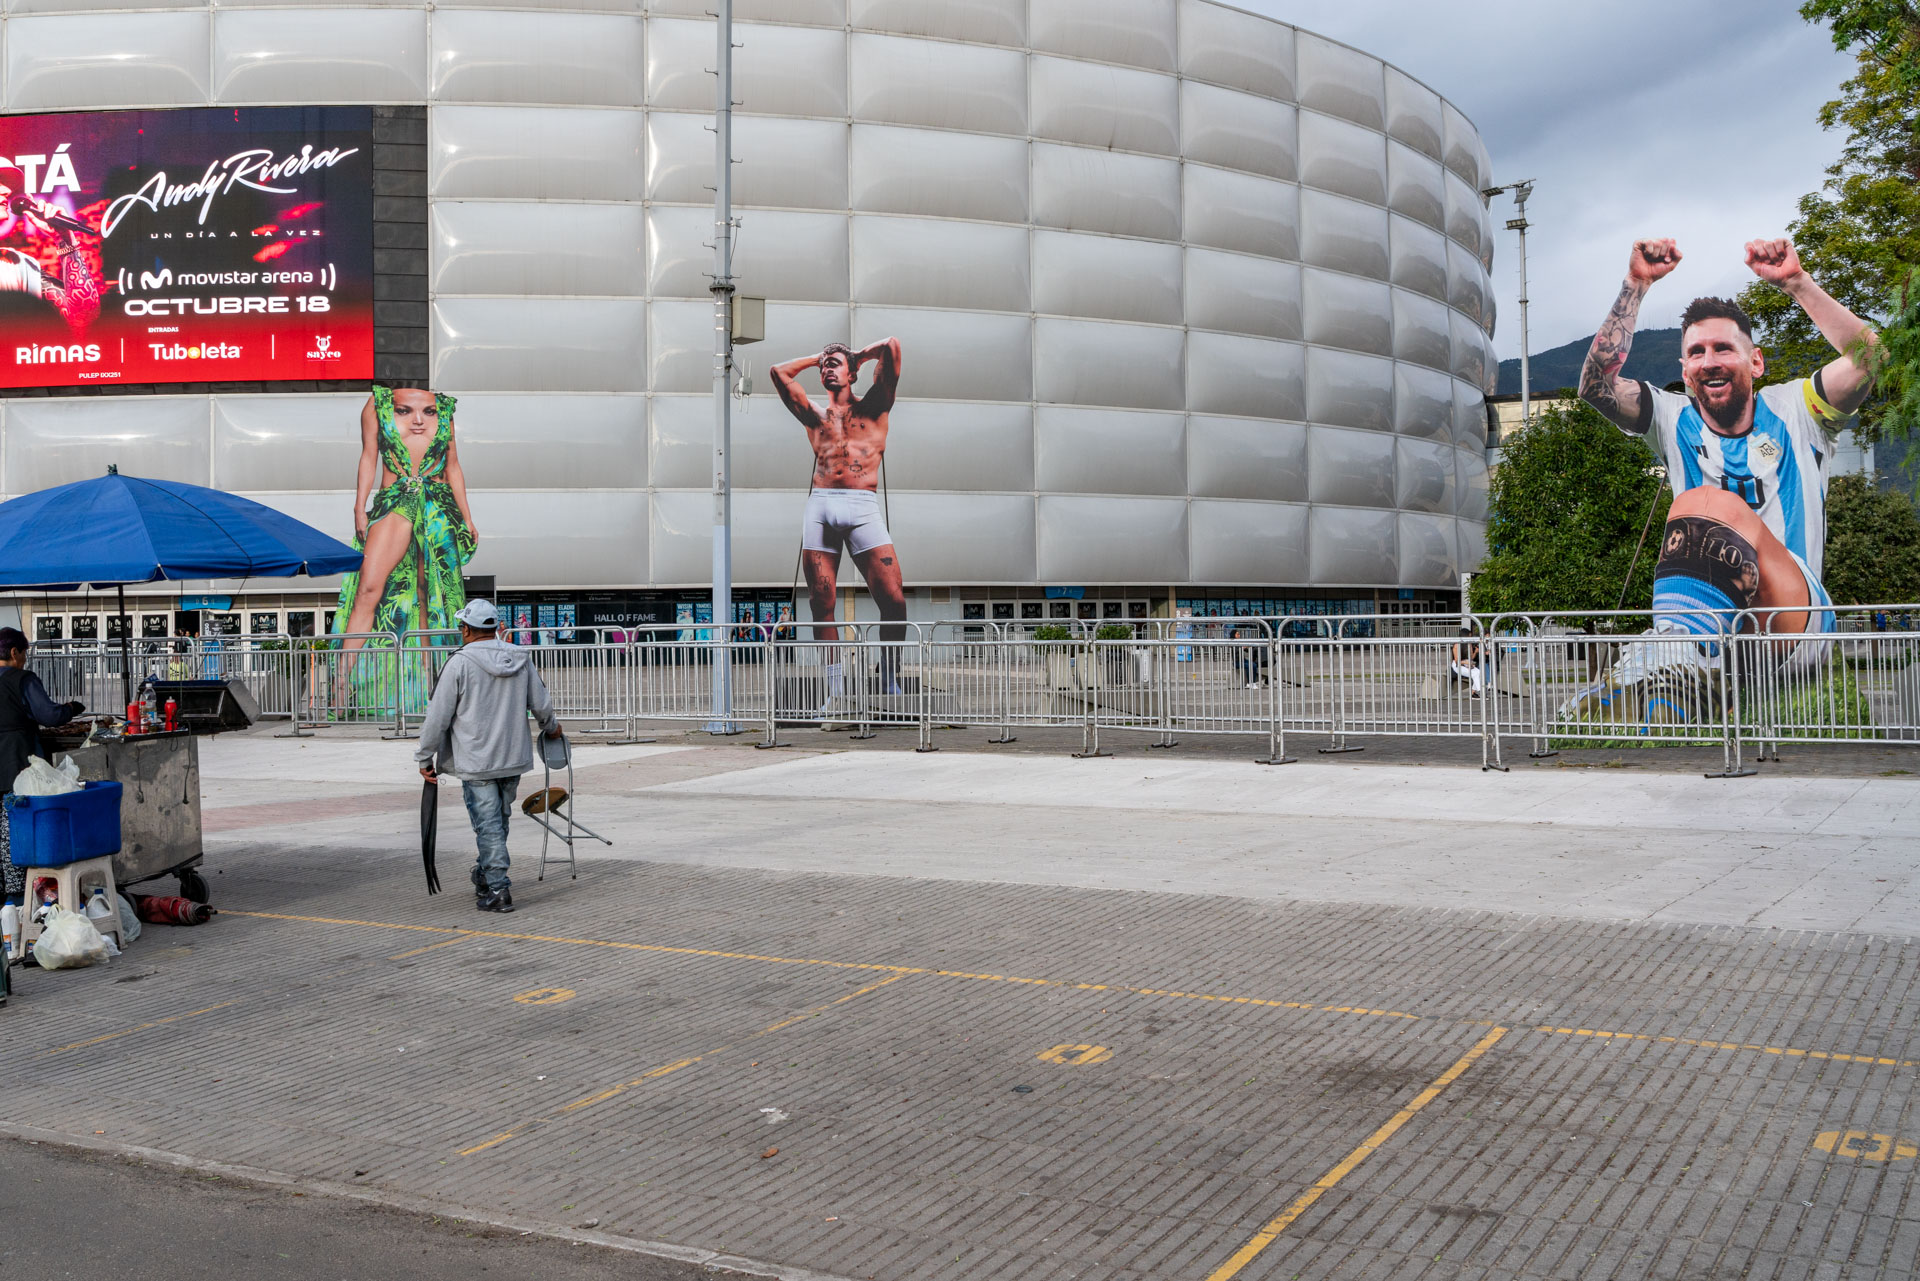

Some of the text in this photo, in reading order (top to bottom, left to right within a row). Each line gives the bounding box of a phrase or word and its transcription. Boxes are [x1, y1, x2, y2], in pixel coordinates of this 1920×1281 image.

[0, 143, 81, 194] TÁ
[100, 145, 359, 239] Andy Rivera
[286, 229, 321, 237] VEZ
[178, 270, 259, 286] movistar
[261, 271, 314, 285] arena
[124, 295, 331, 316] OCTUBRE 18
[306, 350, 341, 360] sayco
[594, 613, 617, 622] HALL
[632, 613, 657, 622] FAME
